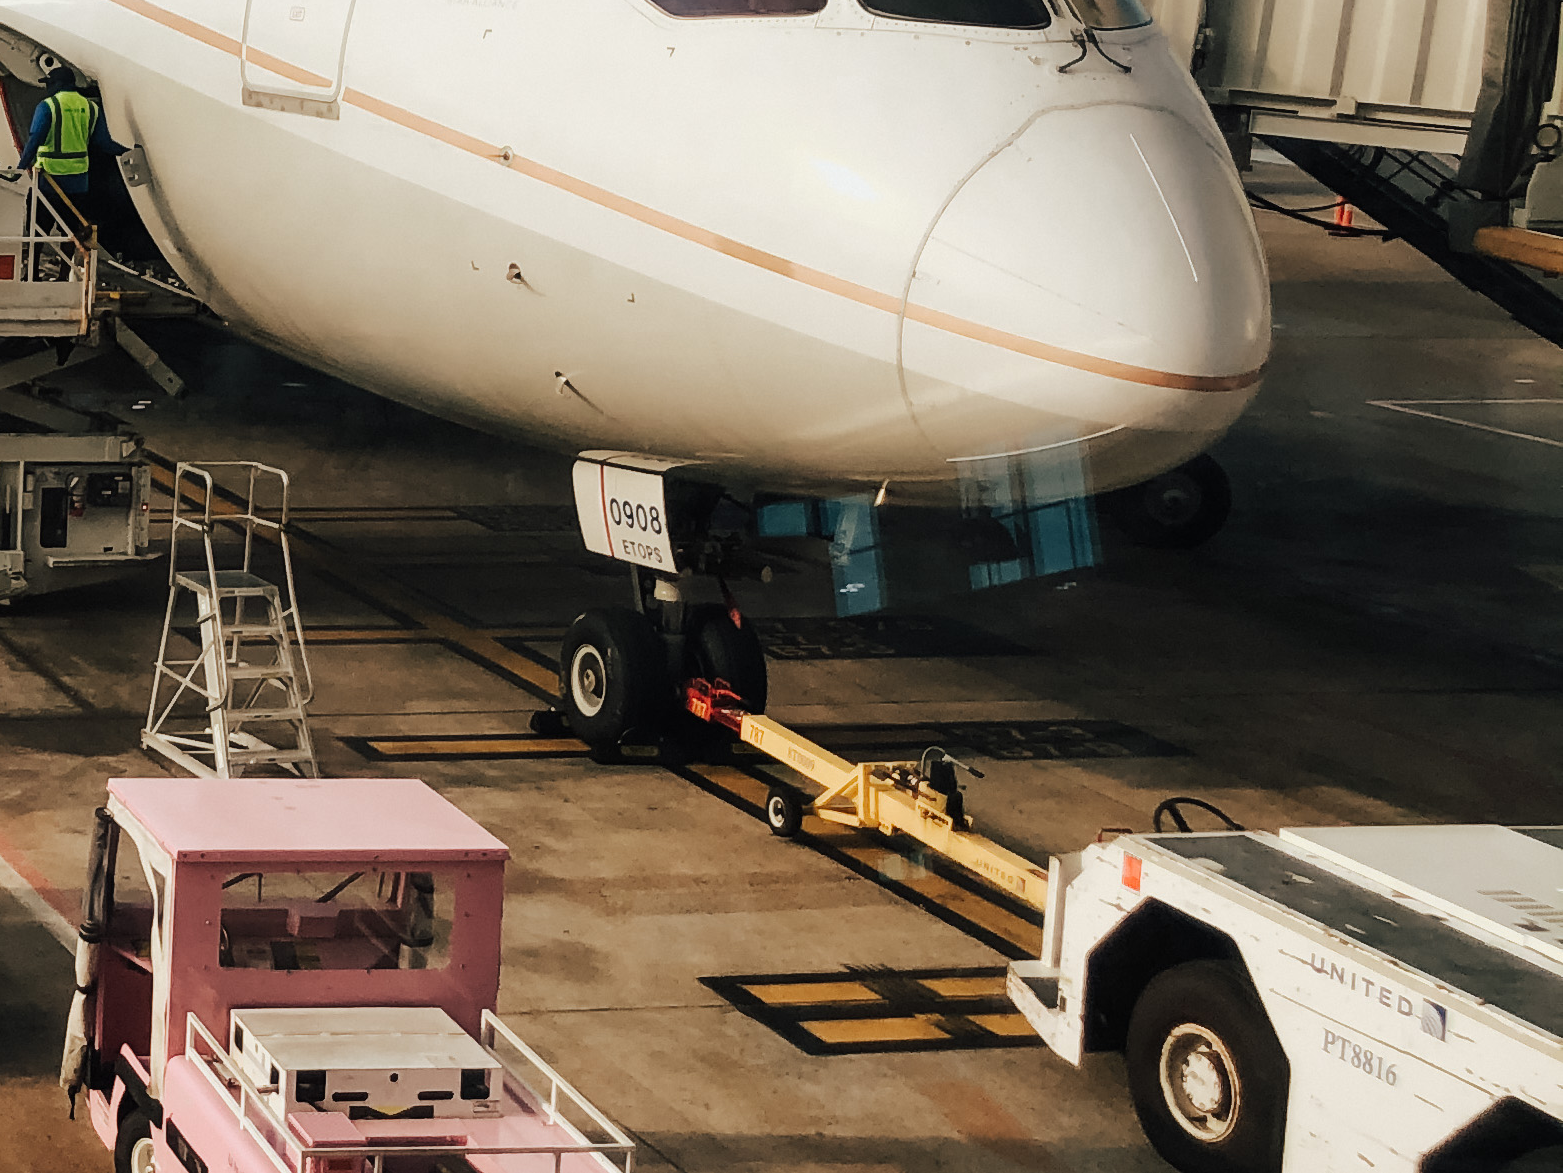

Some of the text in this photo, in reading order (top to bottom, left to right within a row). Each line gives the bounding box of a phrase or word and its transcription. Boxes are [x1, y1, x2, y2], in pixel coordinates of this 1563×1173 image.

[610, 497, 663, 535] 0908
[621, 539, 663, 564] ETOPS
[749, 724, 765, 746] 787
[1310, 952, 1414, 1016] UNITED
[1321, 1028, 1398, 1087] PT8816
